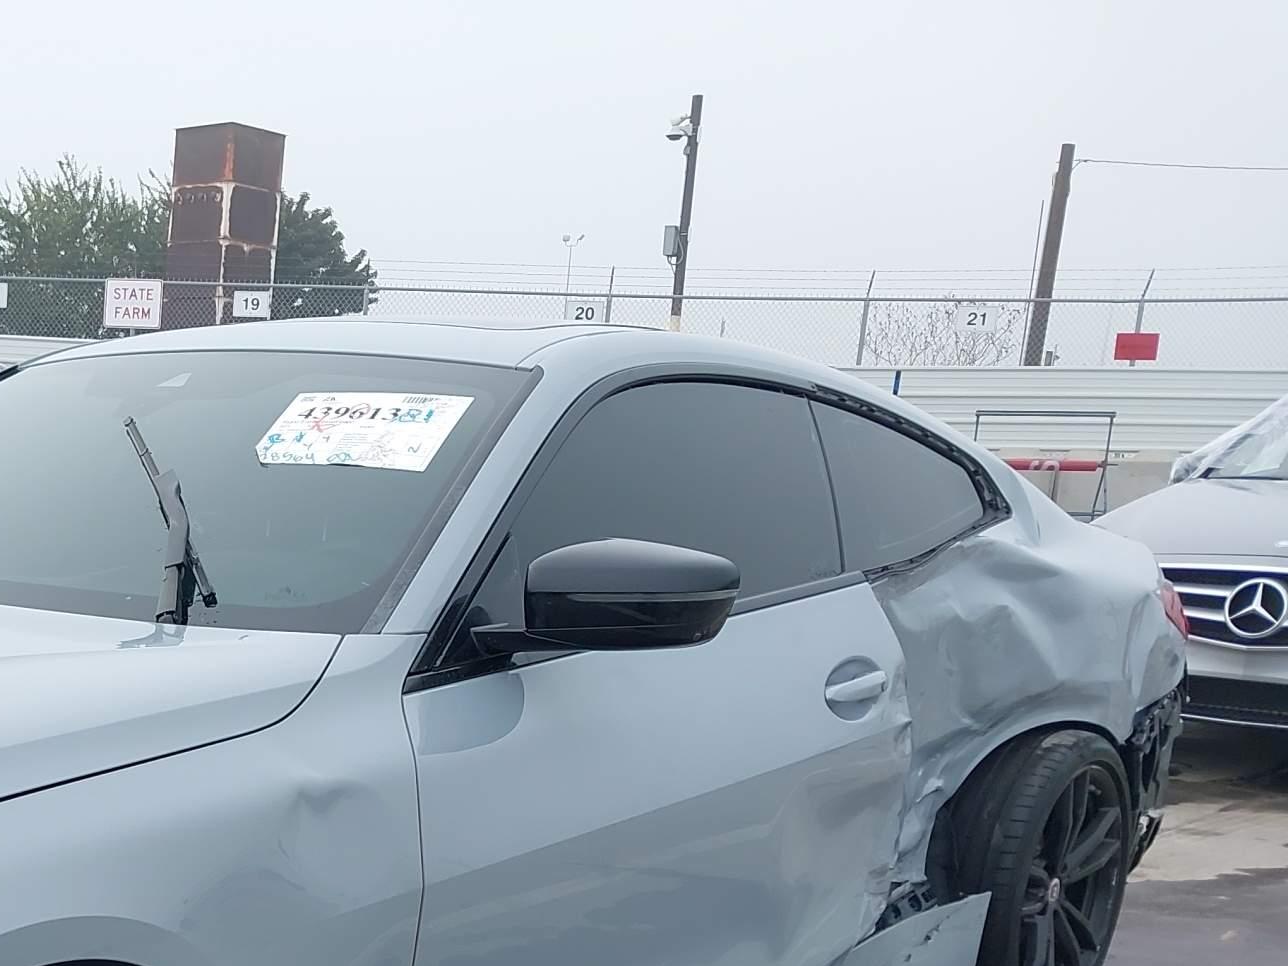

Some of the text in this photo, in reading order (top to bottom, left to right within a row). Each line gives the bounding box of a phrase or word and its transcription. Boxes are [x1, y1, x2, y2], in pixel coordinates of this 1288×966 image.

[113, 287, 154, 301] STATE
[243, 297, 260, 311] 19
[114, 306, 151, 319] FARM
[575, 306, 595, 321] 20
[966, 312, 987, 326] 21
